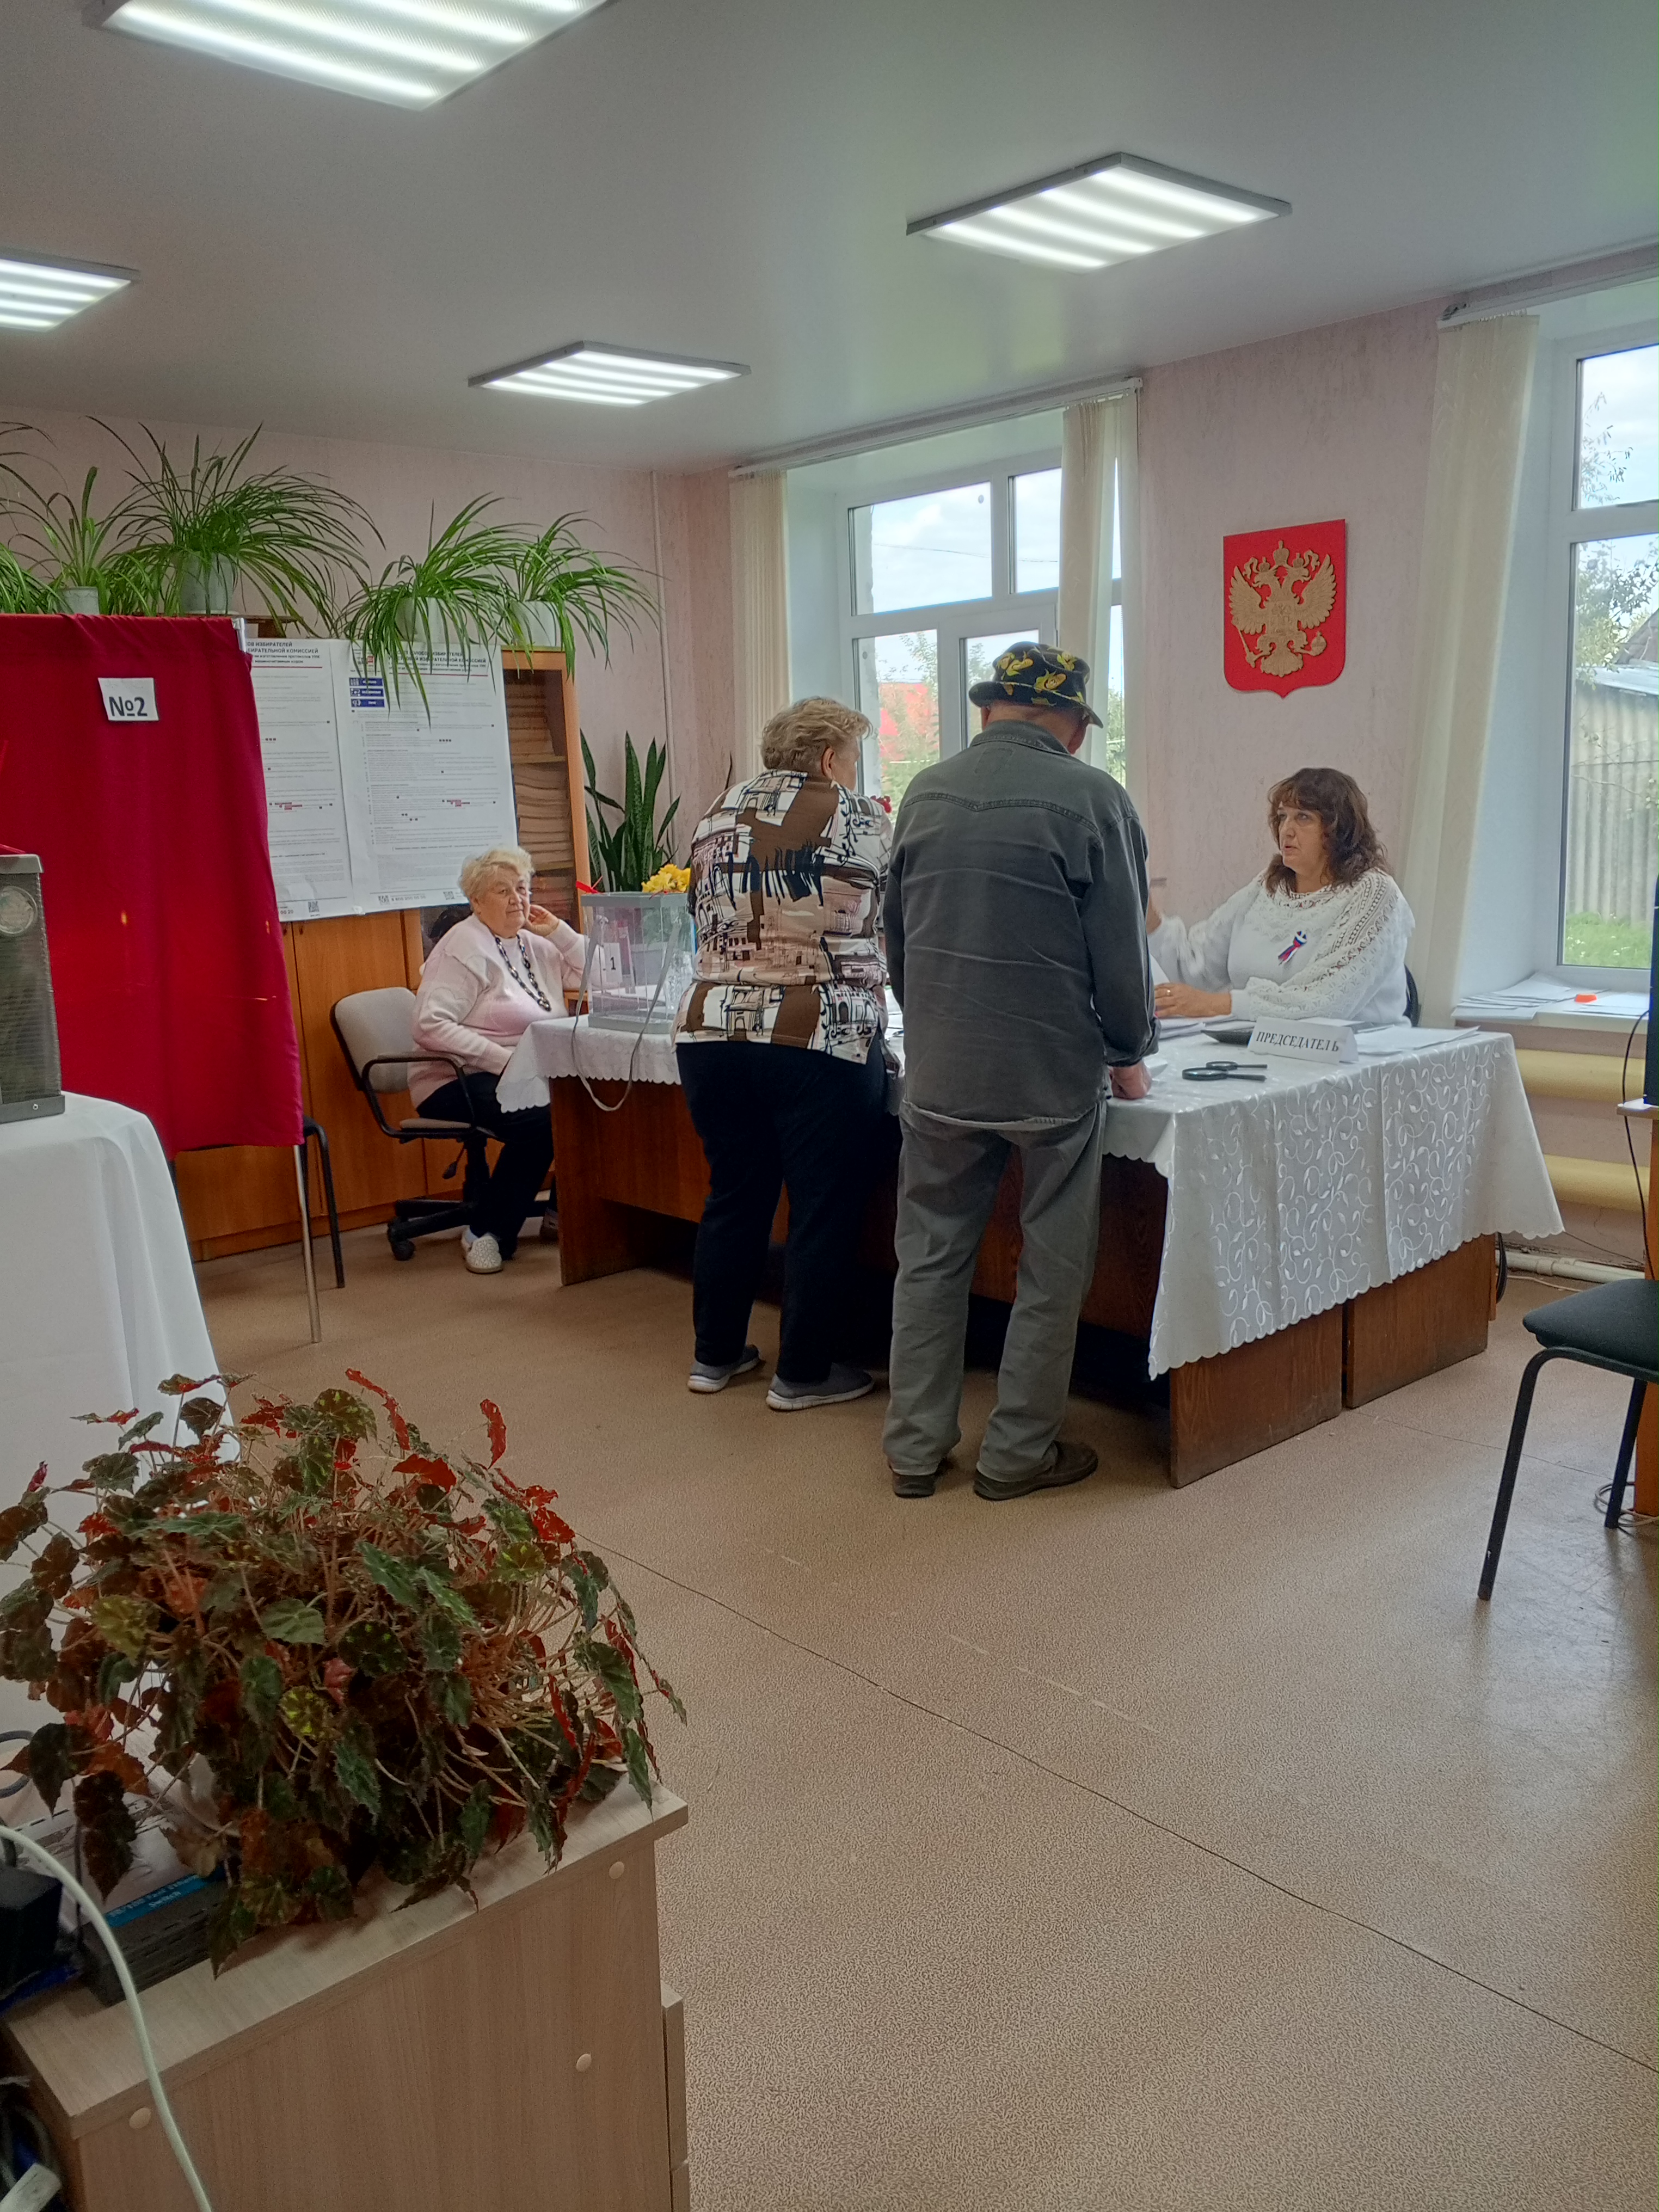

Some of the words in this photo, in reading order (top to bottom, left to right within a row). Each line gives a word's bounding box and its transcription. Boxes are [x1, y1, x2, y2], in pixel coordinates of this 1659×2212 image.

[109, 696, 148, 717] №2
[610, 956, 616, 970] 1
[1256, 1031, 1340, 1052] ПРЕДСЕДАТЕЛЬ
